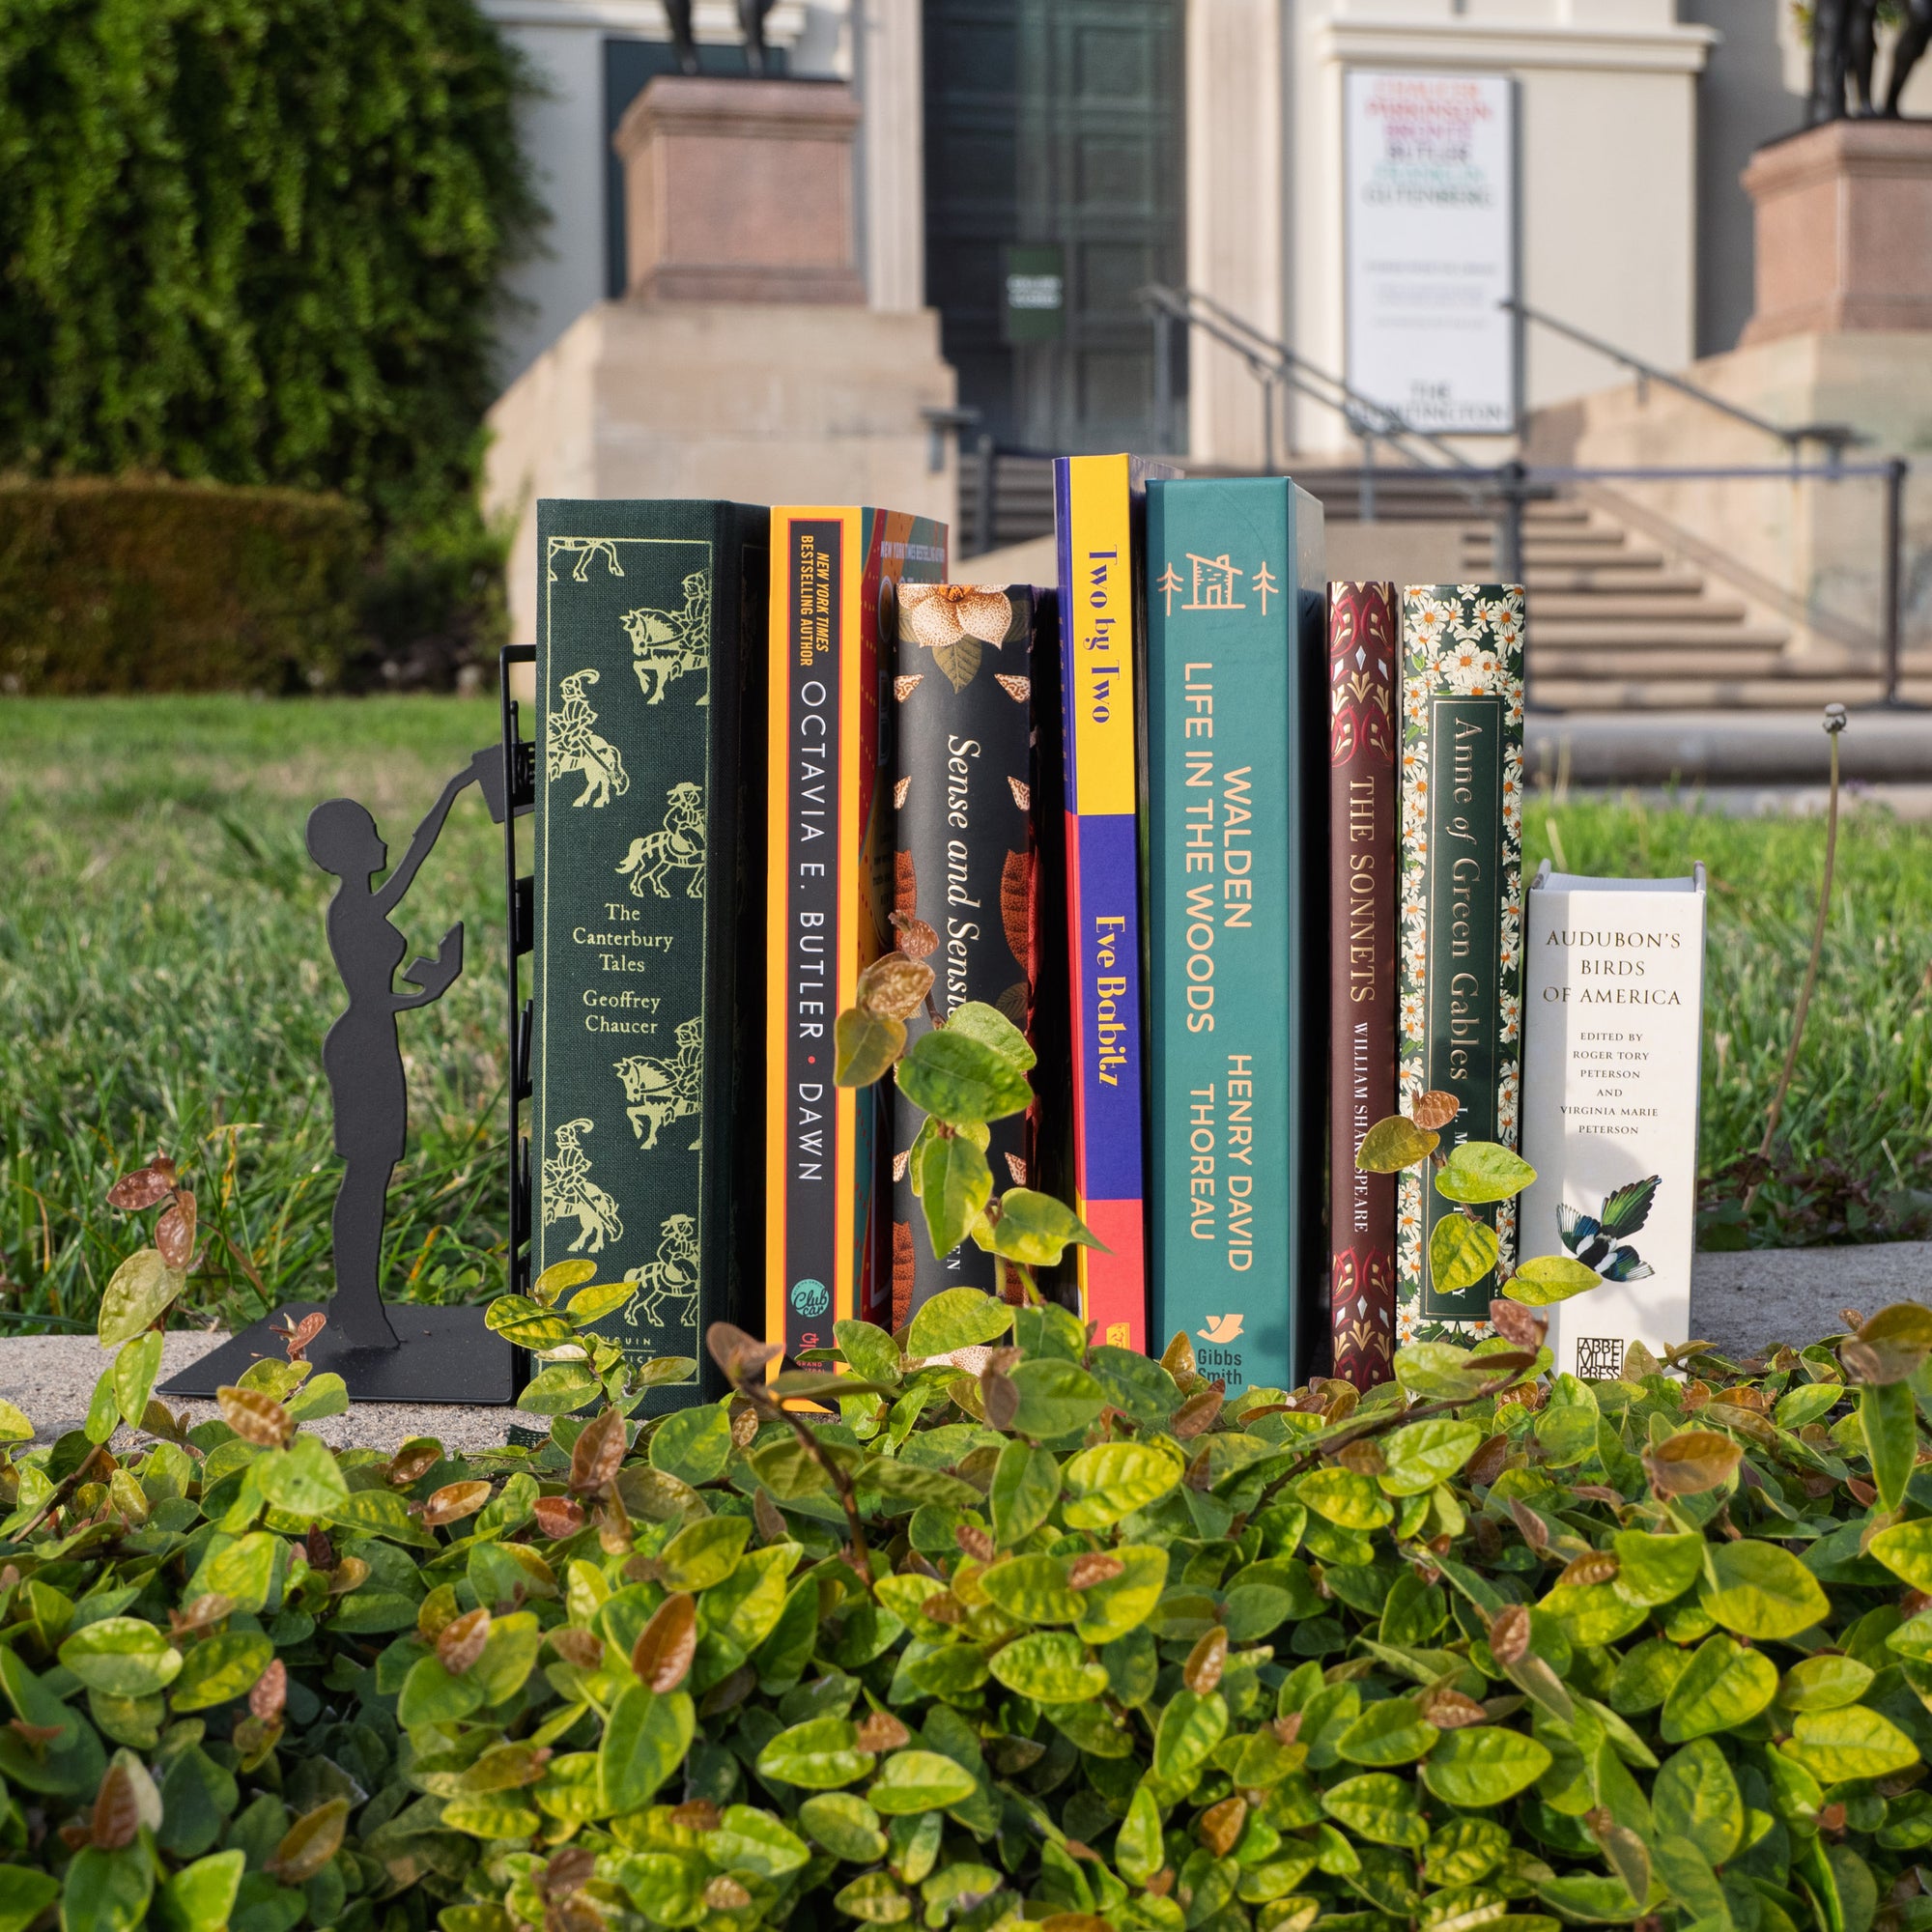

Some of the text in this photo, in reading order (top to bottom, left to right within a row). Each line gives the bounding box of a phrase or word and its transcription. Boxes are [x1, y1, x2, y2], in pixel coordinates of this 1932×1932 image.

[1410, 380, 1450, 400] THE
[800, 535, 813, 667] BESTSELLING AUTHOR
[815, 552, 829, 652] NEW YORK TIMES
[1083, 545, 1120, 724] Two by Two
[1454, 717, 1483, 804] Anne
[948, 734, 980, 829] Sense
[1445, 816, 1477, 846] of
[1185, 663, 1214, 1033] LIFE IN THE WOODS
[1223, 766, 1252, 927] WALDEN
[947, 839, 980, 908] and
[604, 902, 640, 921] The
[1452, 858, 1481, 959] Green
[573, 926, 673, 952] Canterbury
[798, 680, 826, 1181] OCTAVIA E. BUTLER DAWN
[1546, 930, 1681, 949] AUDUBON'S
[599, 953, 645, 972] Tales
[1580, 959, 1645, 976] BIRDS
[582, 989, 661, 1013] Geoffrey
[1095, 916, 1128, 1087] Eve Babitz
[1350, 776, 1376, 1233] THE SONNETS WILLIAM SHAKSPEARE
[1543, 986, 1682, 1006] OF AMERICA
[584, 1015, 658, 1034] Chaucer
[1450, 973, 1480, 1080] Gables
[1580, 1032, 1643, 1041] EDITED BY
[1573, 1051, 1650, 1061] ROGER TORY
[1580, 1069, 1640, 1079] PETERSON
[1597, 1089, 1623, 1097] AND
[1560, 1106, 1659, 1117] VIRGINIA MARIE
[1454, 1131, 1468, 1146] M
[1578, 1125, 1639, 1134] PETERSON
[1190, 1083, 1215, 1240] THOREAU
[1228, 1055, 1253, 1271] HENRY DAVID
[794, 1288, 828, 1310] Club
[803, 1305, 824, 1316] car
[1198, 1349, 1242, 1366] Gibbs
[1198, 1368, 1242, 1385] Smith
[1579, 1366, 1620, 1380] PRESS
